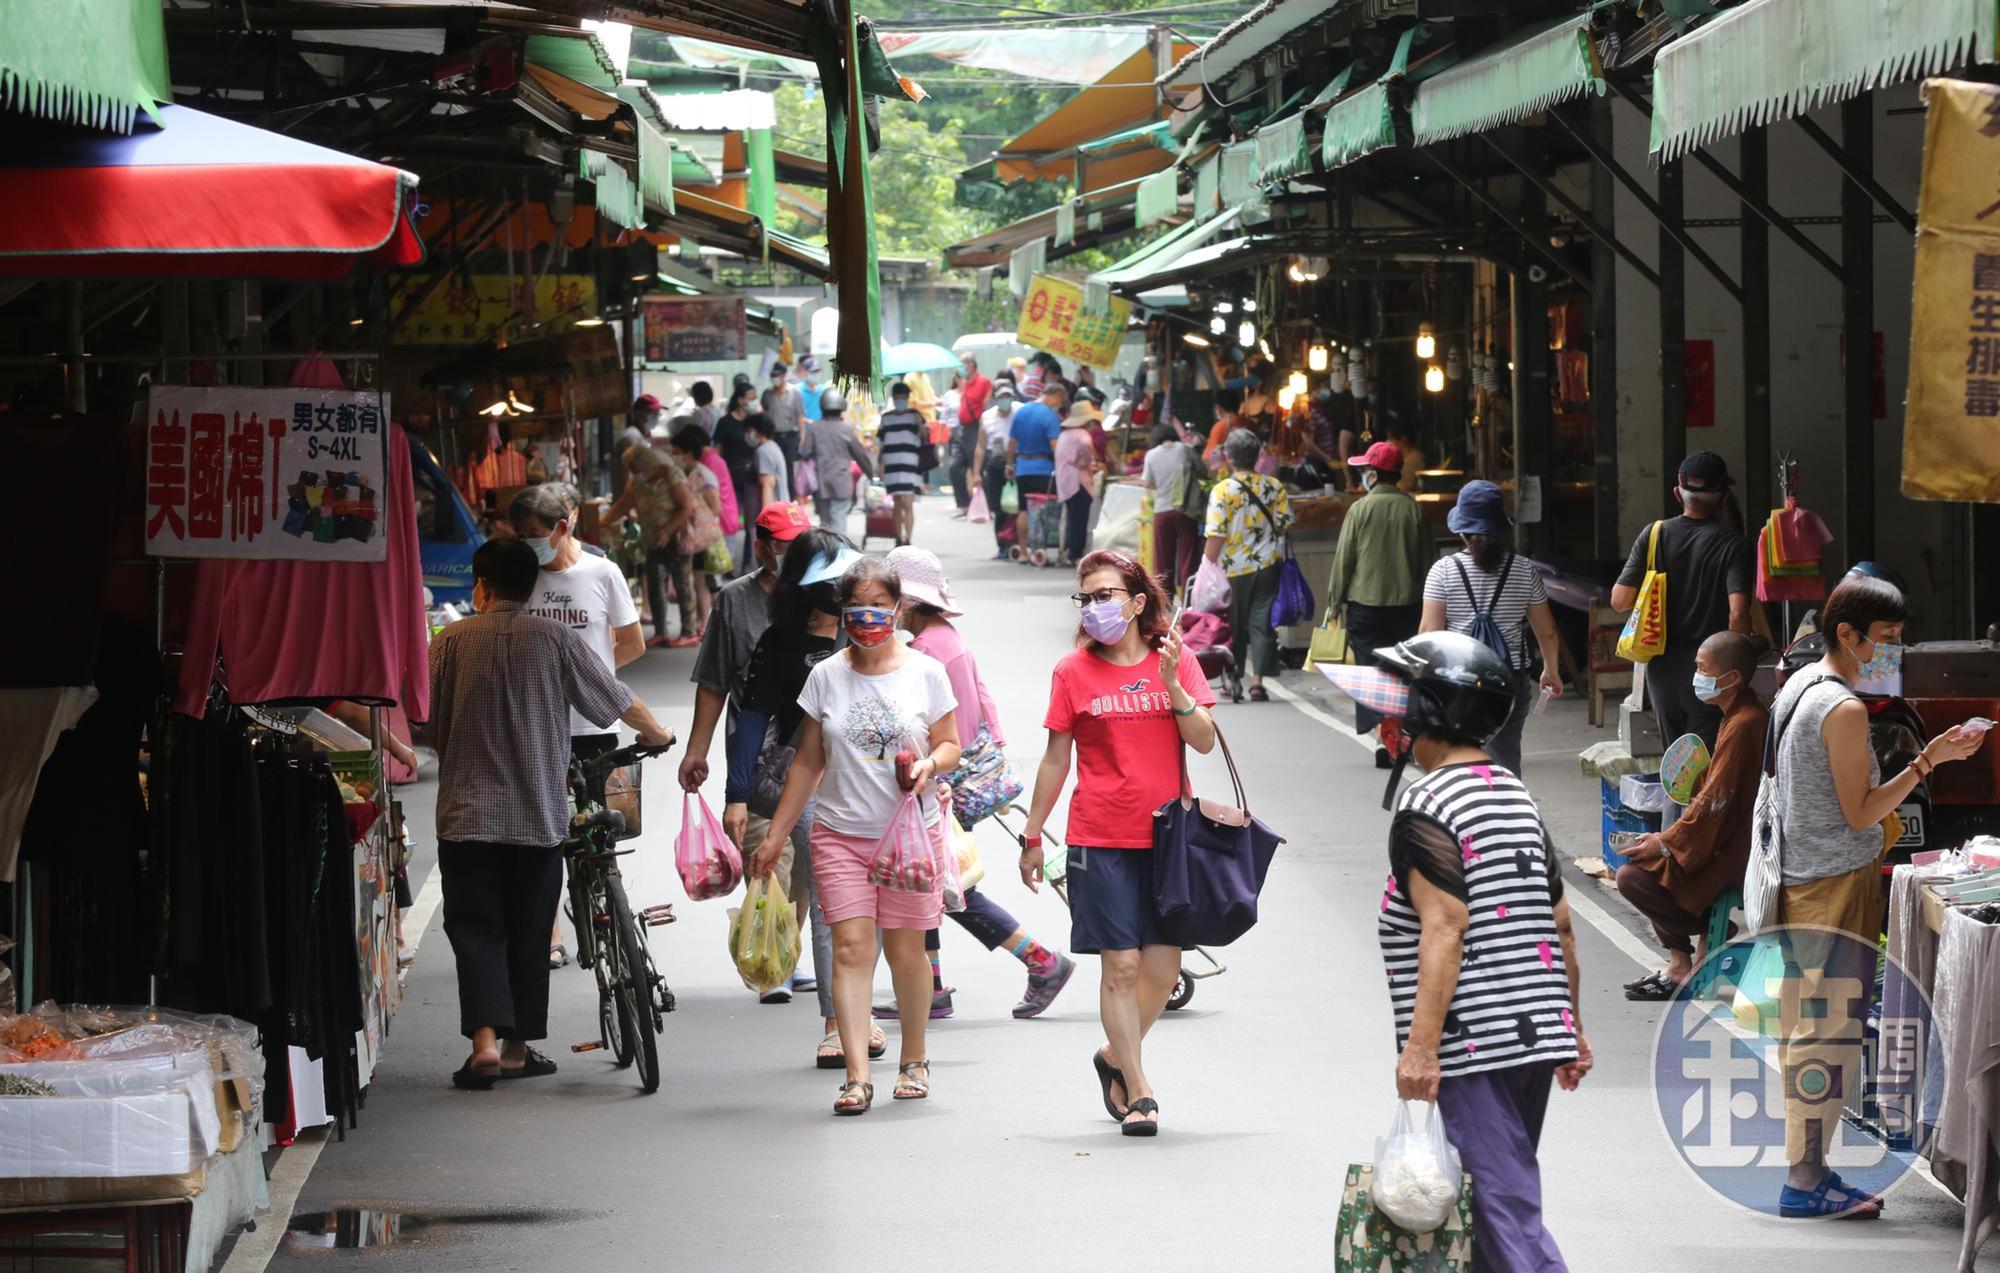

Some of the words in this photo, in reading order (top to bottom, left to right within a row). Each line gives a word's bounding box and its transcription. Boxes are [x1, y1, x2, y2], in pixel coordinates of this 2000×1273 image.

[292, 402, 379, 434] 男女都有
[308, 435, 362, 461] S~4XL
[147, 408, 287, 543] 美國棉T
[543, 591, 573, 608] Keep
[1091, 691, 1172, 716] HOLLISTE
